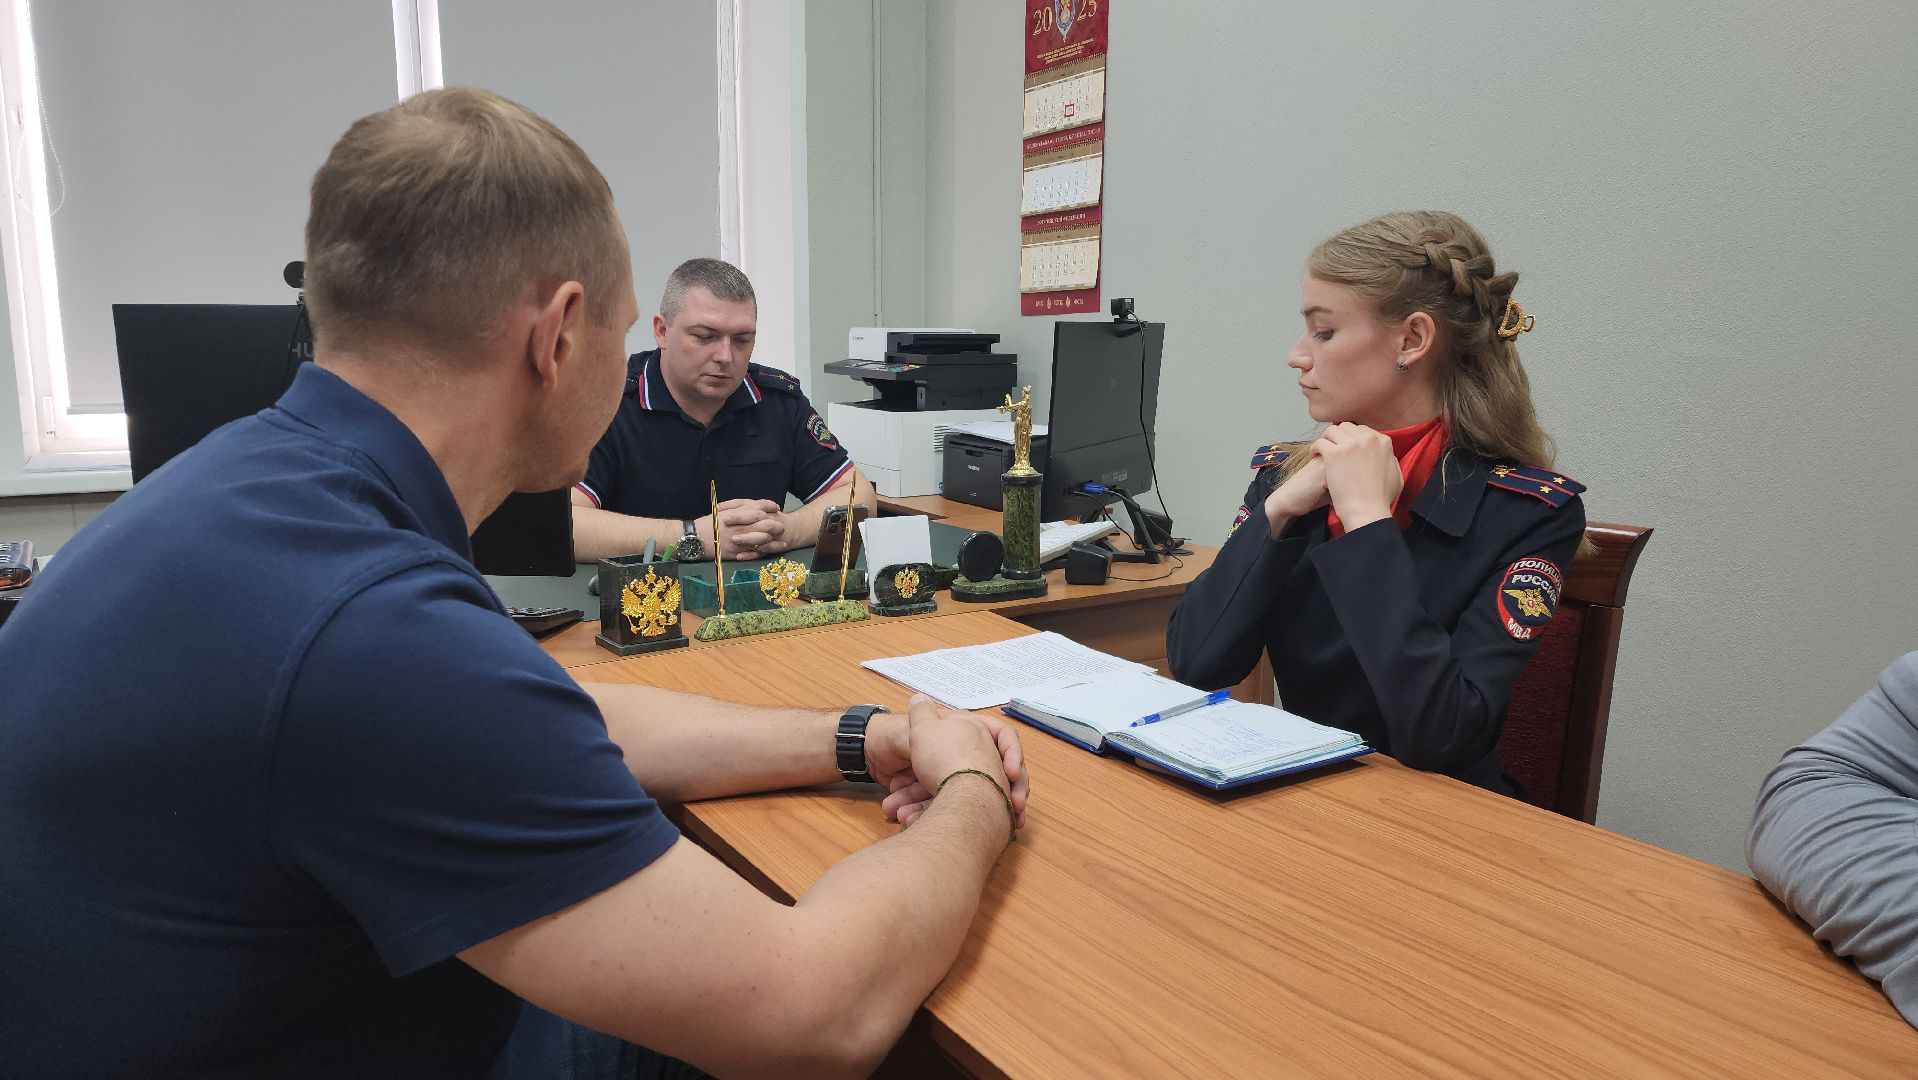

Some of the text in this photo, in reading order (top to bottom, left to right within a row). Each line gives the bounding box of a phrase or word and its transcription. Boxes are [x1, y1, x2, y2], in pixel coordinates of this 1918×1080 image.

[1032, 0, 1097, 36] 20 25
[1511, 574, 1557, 606] РОССИЯ
[1507, 618, 1532, 640] МВД
